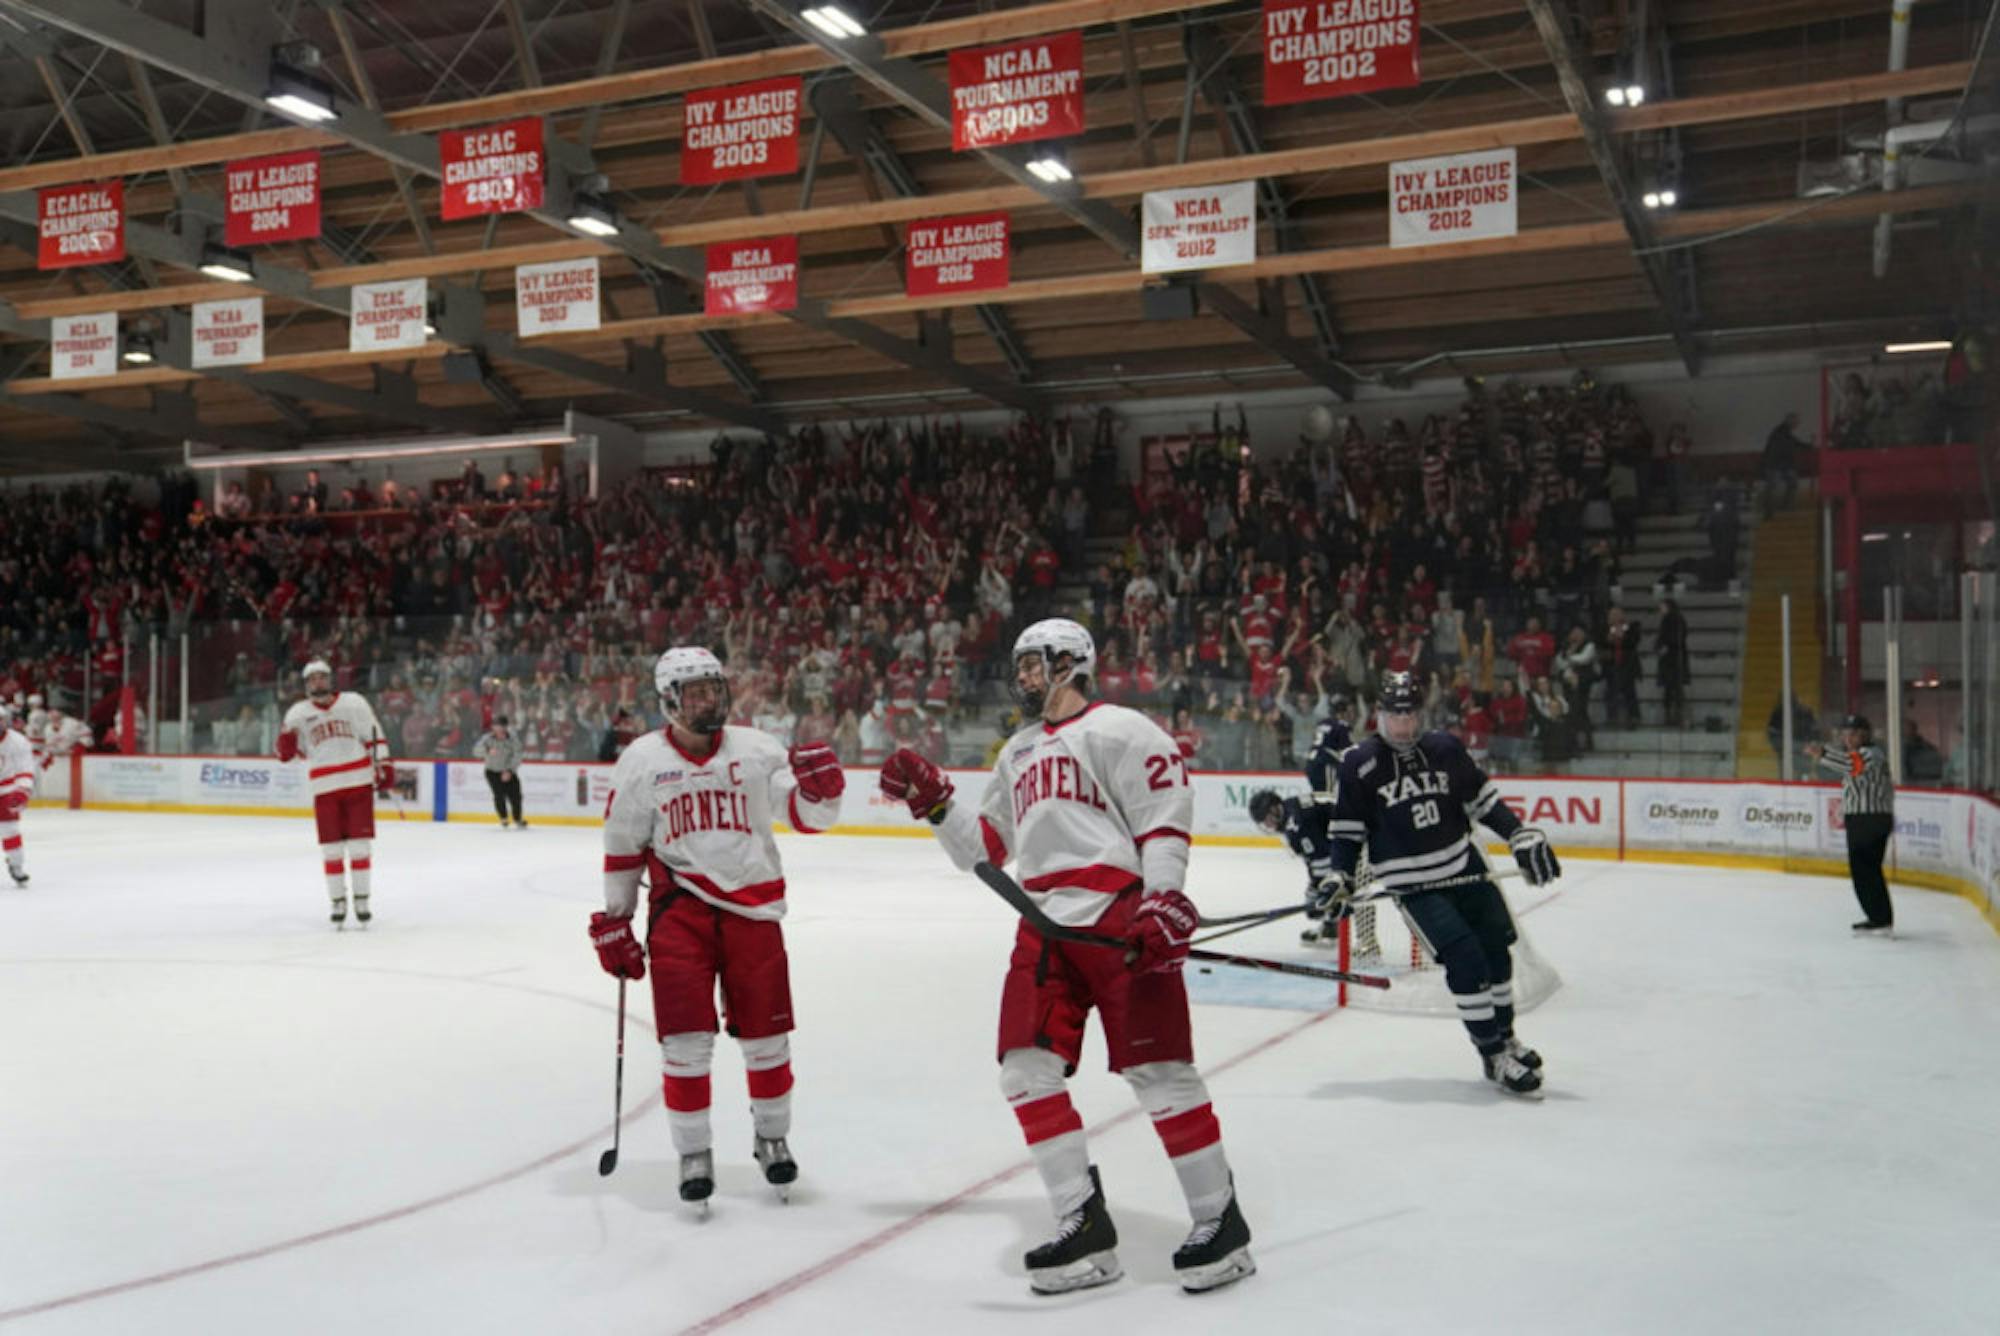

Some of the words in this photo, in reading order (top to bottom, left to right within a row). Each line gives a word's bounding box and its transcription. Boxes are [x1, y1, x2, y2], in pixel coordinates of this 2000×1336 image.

[1268, 8, 1307, 36] IVY
[1317, 0, 1413, 28] LEAGUE
[1269, 19, 1412, 63] CHAMPIONS
[985, 46, 1052, 79] NCAA
[1303, 51, 1376, 85] 2002
[954, 70, 1079, 110] TOURNAMENT
[686, 102, 716, 124] IVY
[723, 90, 796, 119] LEAGUE
[988, 101, 1048, 131] 2003
[464, 131, 516, 157] ECAC
[687, 114, 794, 149] CHAMPIONS
[446, 152, 538, 185] CHAMPIONS
[713, 141, 767, 168] 2003
[229, 171, 254, 192] IVY
[258, 163, 317, 188] LEAGUE
[1395, 172, 1427, 192] IVY
[1435, 161, 1510, 188] LEAGUE
[231, 184, 314, 213] CHAMPIONS
[1174, 197, 1221, 219] NCAA
[1397, 184, 1508, 213] CHAMPIONS
[41, 209, 118, 238] CHAMPIONS
[252, 210, 289, 231] 2004
[911, 229, 938, 248] IVY
[943, 220, 1005, 245] LEAGUE
[1429, 209, 1472, 231] 2012
[732, 248, 771, 267] NCAA
[913, 240, 1003, 268] CHAMPIONS
[1177, 239, 1216, 258] 2012
[544, 268, 594, 288] LEAGUE
[708, 263, 796, 288] TOURNAMENT
[938, 263, 974, 284] 2012
[522, 287, 593, 308] CHAMPIONS
[356, 304, 422, 326] CHAMPIONS
[728, 762, 743, 786] C
[1377, 770, 1450, 807] YALE
[1411, 799, 1441, 829] 20
[1649, 803, 1719, 821] DiSanto
[1745, 806, 1813, 826] DiSanto
